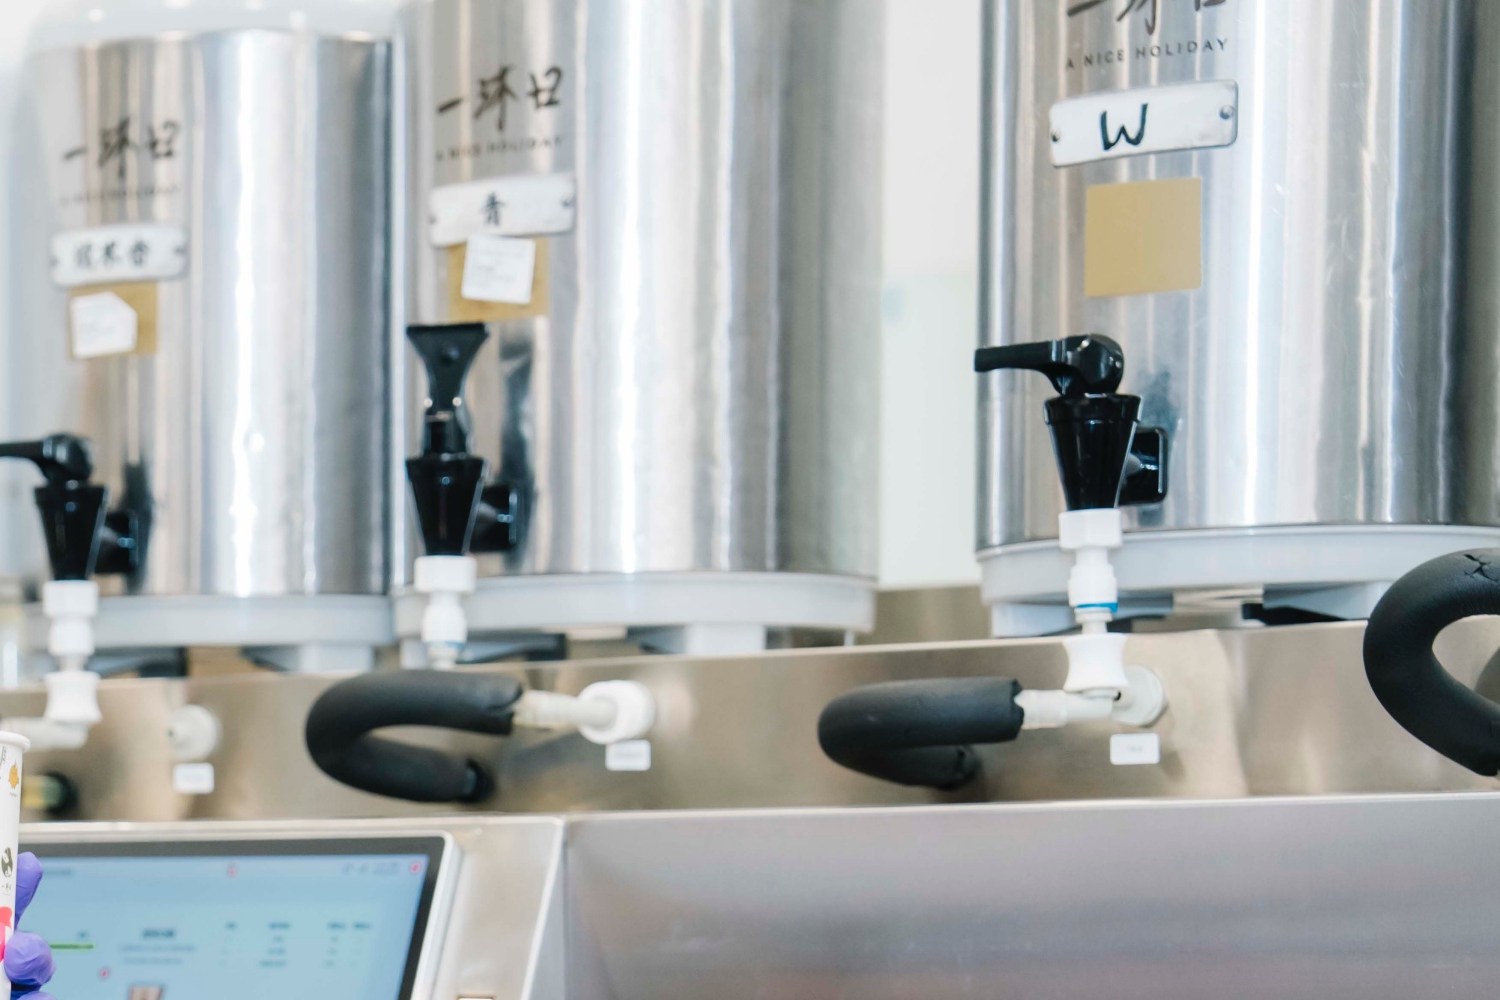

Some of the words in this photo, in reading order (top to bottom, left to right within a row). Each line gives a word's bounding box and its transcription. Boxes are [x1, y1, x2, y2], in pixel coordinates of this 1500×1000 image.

[1066, 58, 1074, 69] A
[1084, 49, 1124, 66] NICE
[1136, 38, 1228, 59] HOLIDAY
[1099, 102, 1148, 150] W
